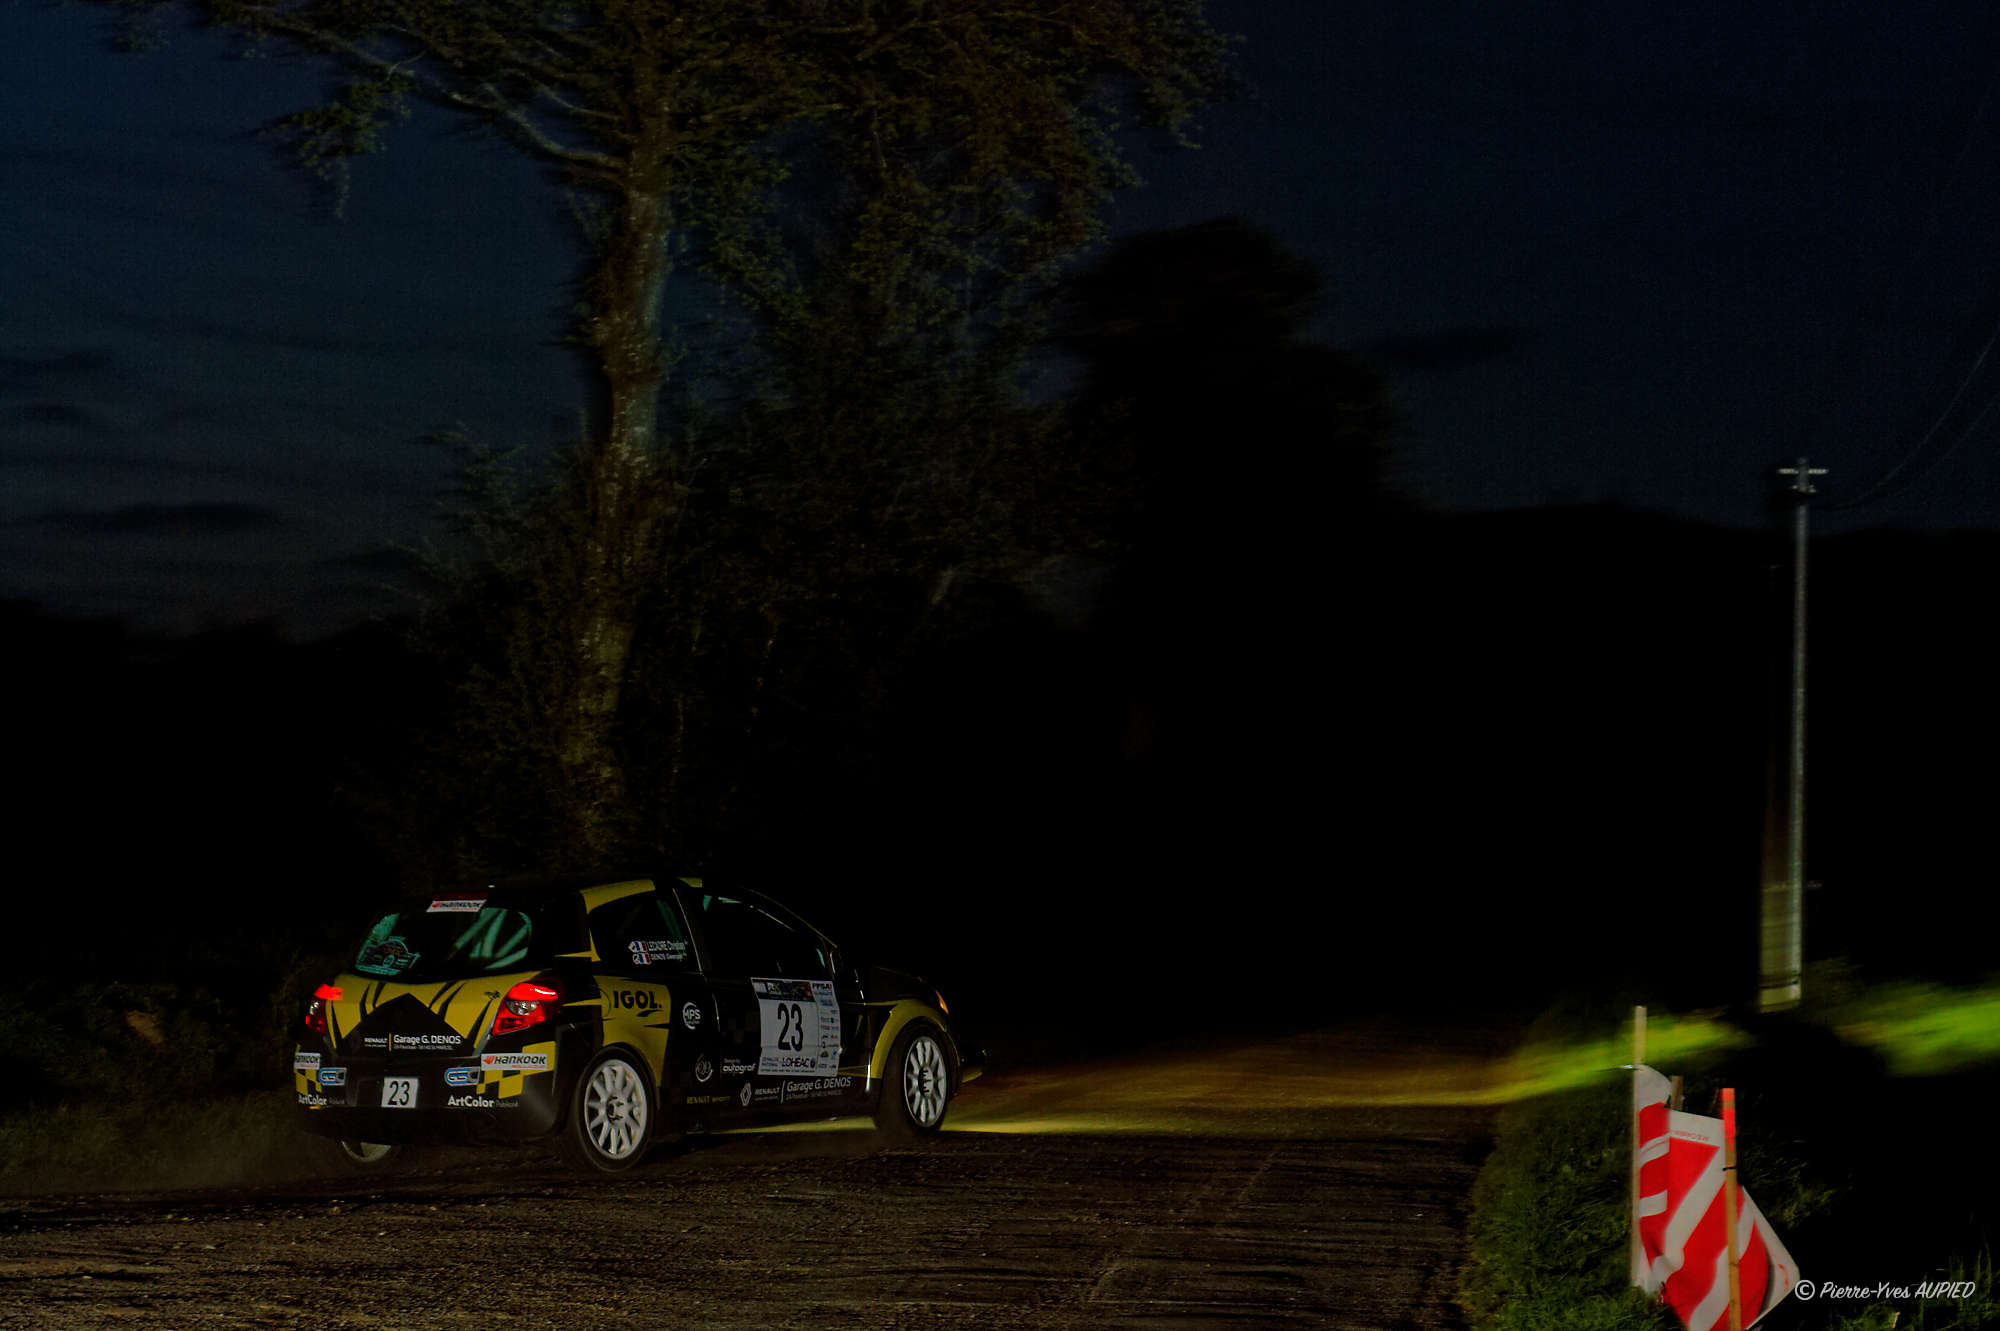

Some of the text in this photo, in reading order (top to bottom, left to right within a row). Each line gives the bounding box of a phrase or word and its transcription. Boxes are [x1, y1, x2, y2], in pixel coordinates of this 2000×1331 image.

[777, 1002, 804, 1052] 23
[393, 1034, 420, 1046] Garage
[431, 1035, 461, 1045] DENOS
[722, 1063, 756, 1074] autograf
[786, 1081, 813, 1094] Garage
[823, 1076, 852, 1089] DENOS
[388, 1080, 410, 1106] 23
[447, 1095, 495, 1108] ArtColor
